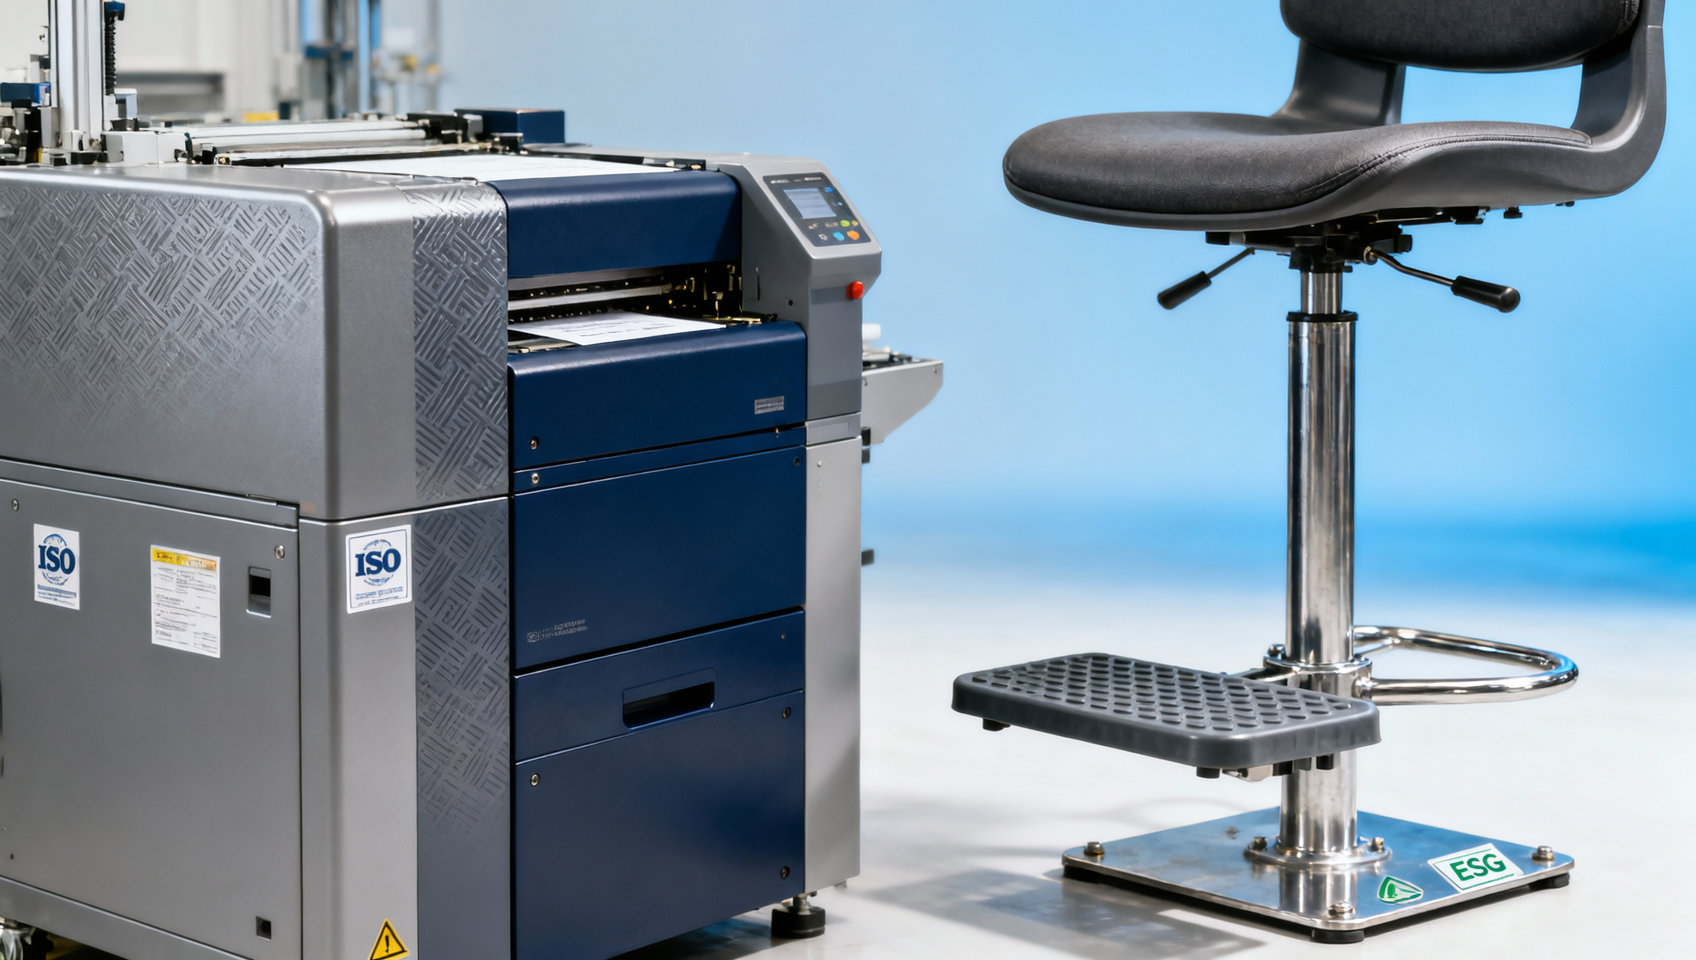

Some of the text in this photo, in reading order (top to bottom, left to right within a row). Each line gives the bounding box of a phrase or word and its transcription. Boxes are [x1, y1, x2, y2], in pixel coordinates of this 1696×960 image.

[38, 544, 76, 575] ISO
[355, 548, 402, 577] ISO
[1449, 853, 1507, 882] ESG
